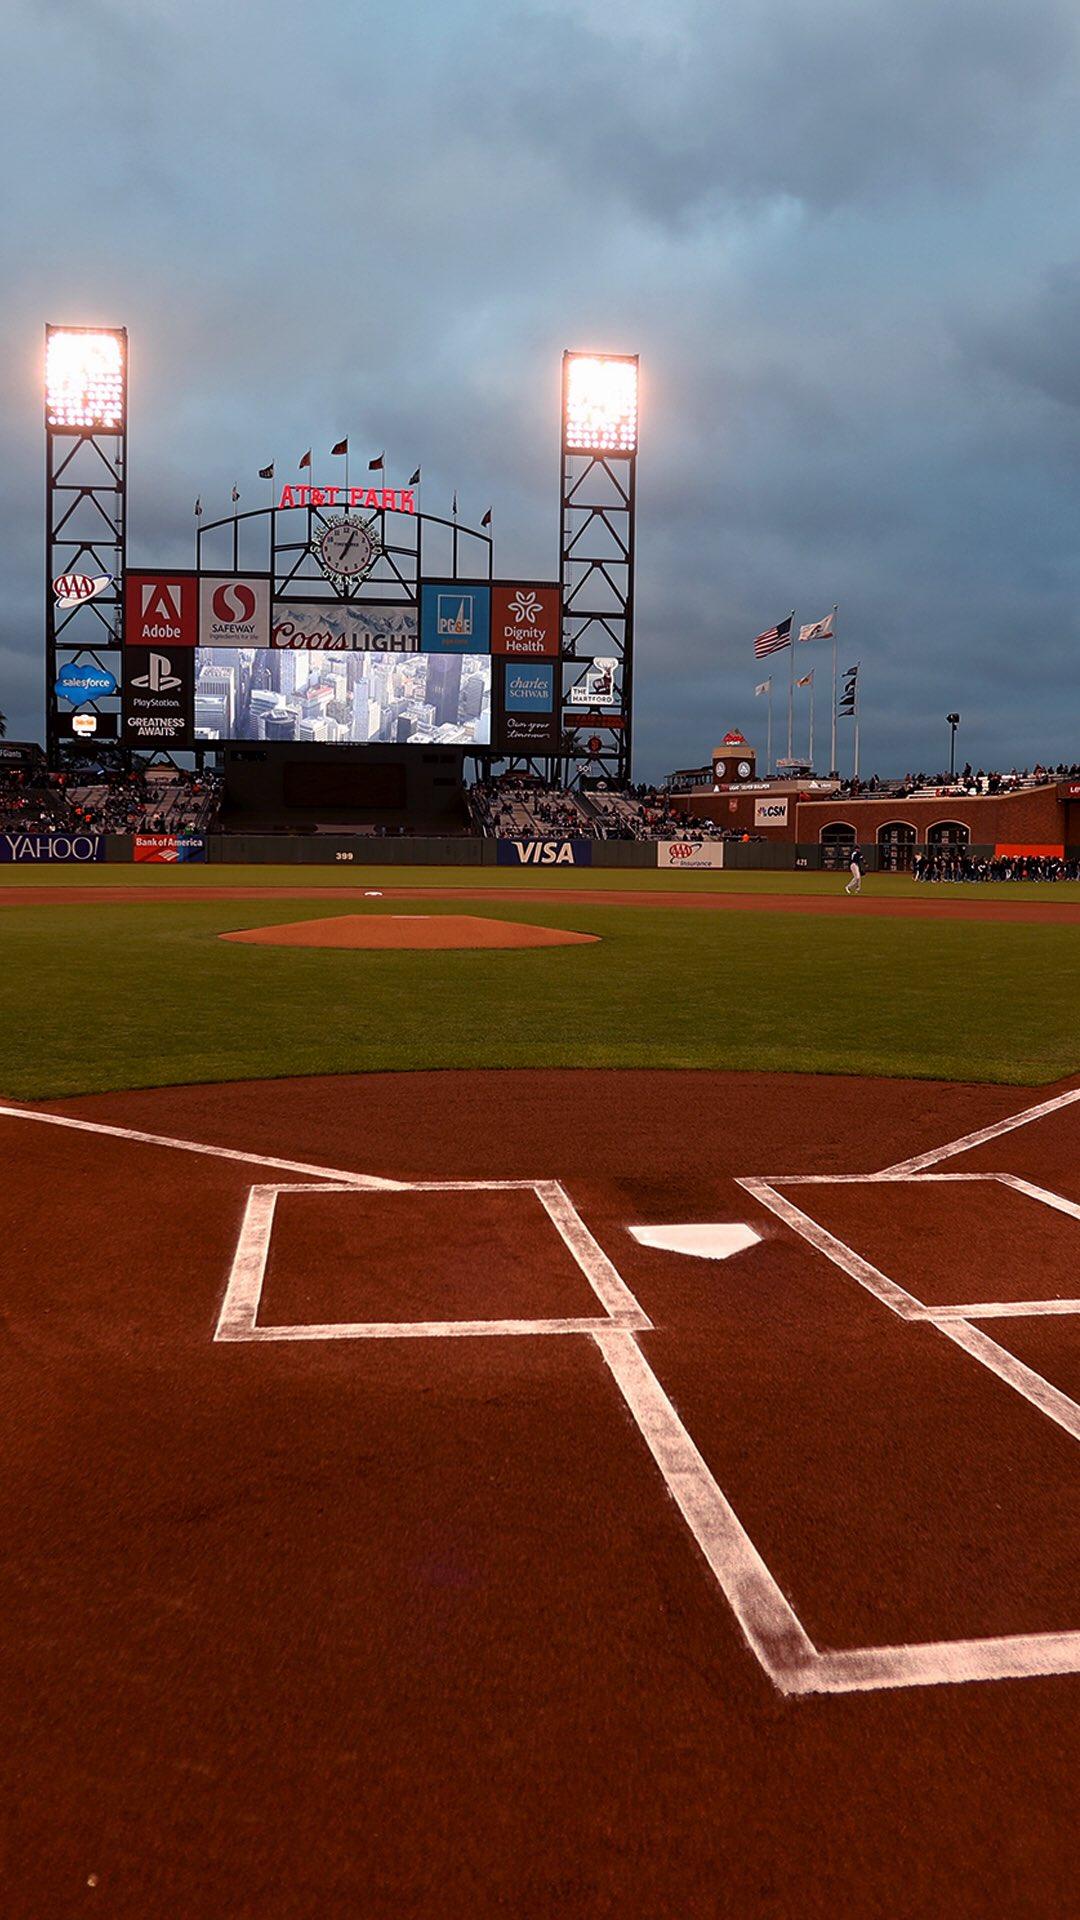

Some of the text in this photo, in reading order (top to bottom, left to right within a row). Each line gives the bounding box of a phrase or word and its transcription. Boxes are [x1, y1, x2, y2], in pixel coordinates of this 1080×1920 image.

[278, 484, 415, 514] AT&T PARK
[322, 564, 373, 585] GIANTS
[57, 576, 92, 598] AAA
[142, 624, 181, 638] Adobe
[212, 624, 255, 633] SAFEWAY
[440, 618, 471, 634] PG&E
[273, 622, 418, 652] Coors LIGHT
[504, 626, 546, 642] Dignity
[506, 641, 545, 652] Health
[63, 677, 110, 689] salesforce
[510, 677, 548, 690] charles
[510, 690, 549, 698] SCHWAB
[133, 698, 179, 708] PlayStation
[127, 717, 185, 727] GREATNESS
[529, 722, 550, 732] your
[137, 727, 176, 736] AWAITS
[767, 806, 786, 817] CSN
[6, 835, 100, 861] YAHOO!
[135, 838, 203, 847] Bank of America
[335, 852, 354, 860] 399
[511, 841, 576, 864] VISA
